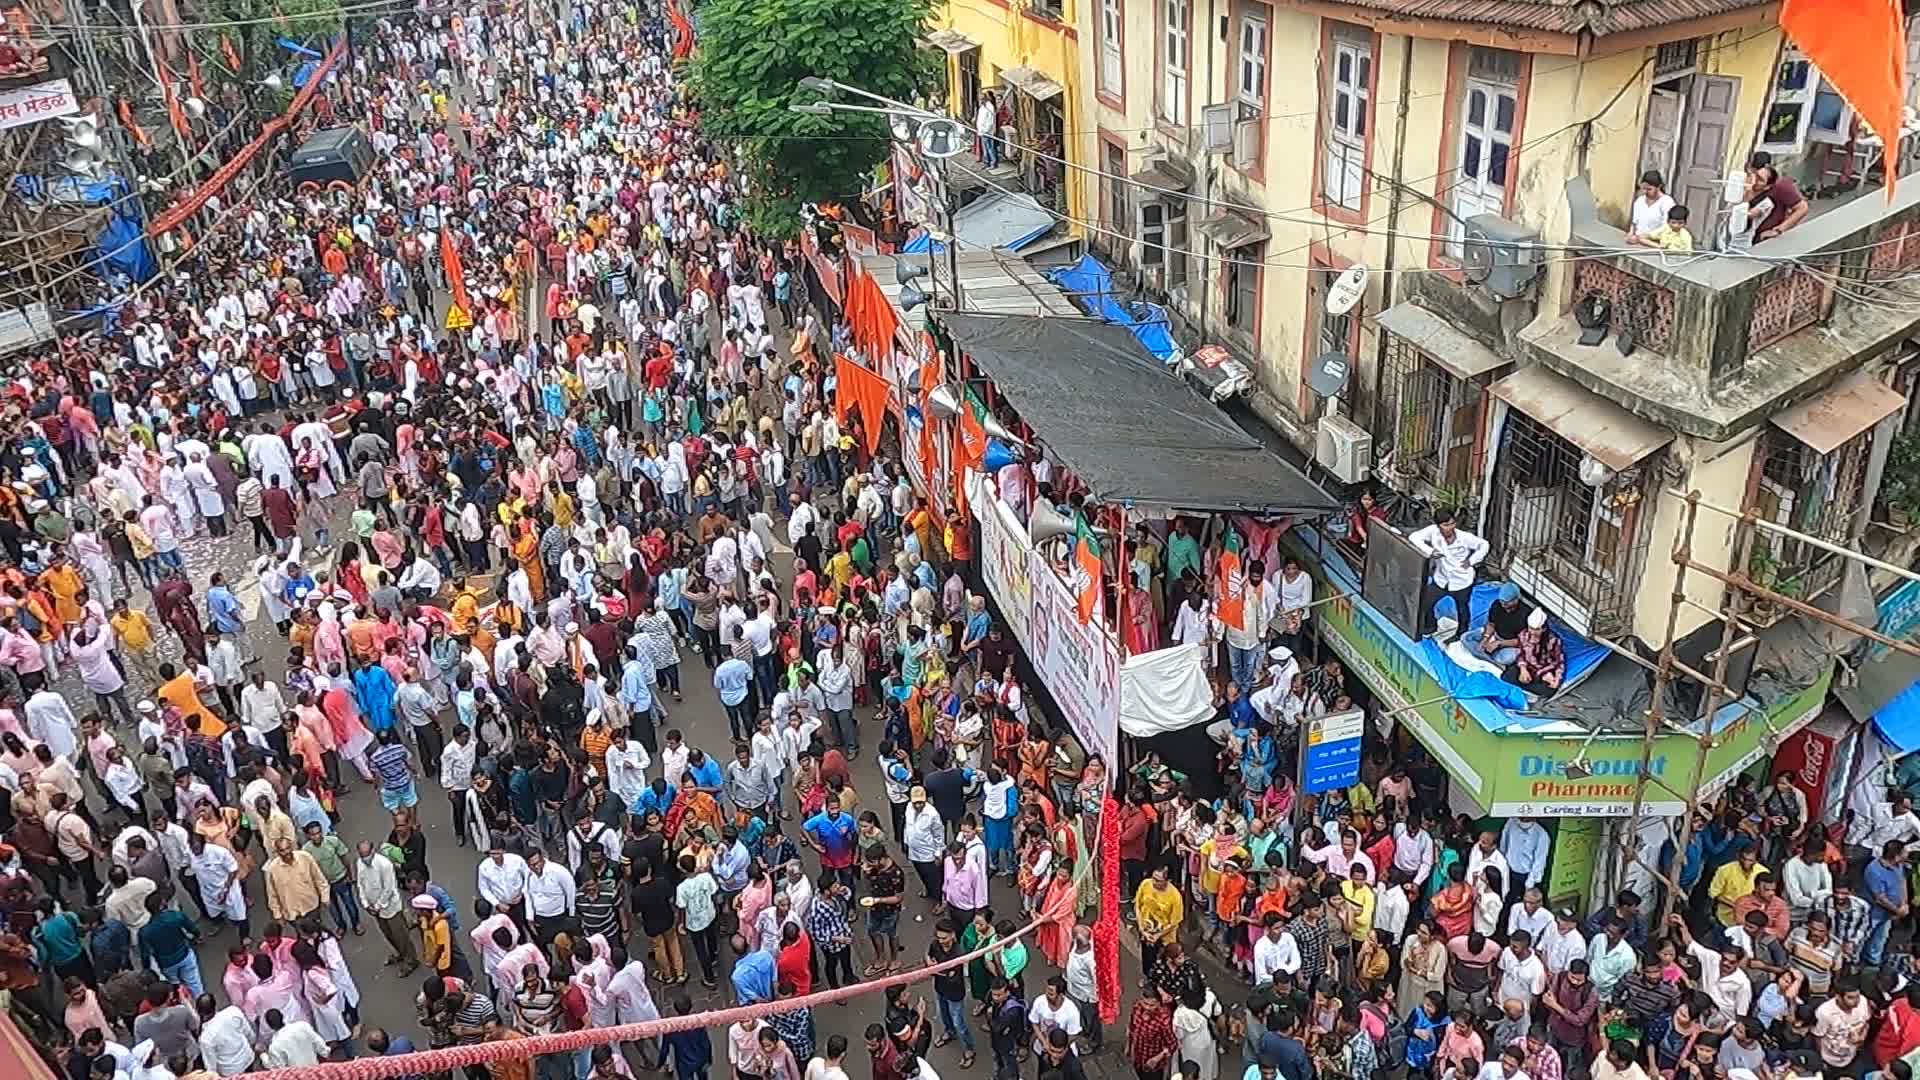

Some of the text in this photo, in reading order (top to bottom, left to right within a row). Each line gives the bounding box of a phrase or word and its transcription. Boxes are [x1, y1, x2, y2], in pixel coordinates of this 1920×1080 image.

[23, 95, 67, 113] मंडळ
[1520, 754, 1667, 777] Disount
[1531, 780, 1636, 798] Pharmac
[1543, 804, 1582, 815] Caring
[1586, 804, 1602, 813] for
